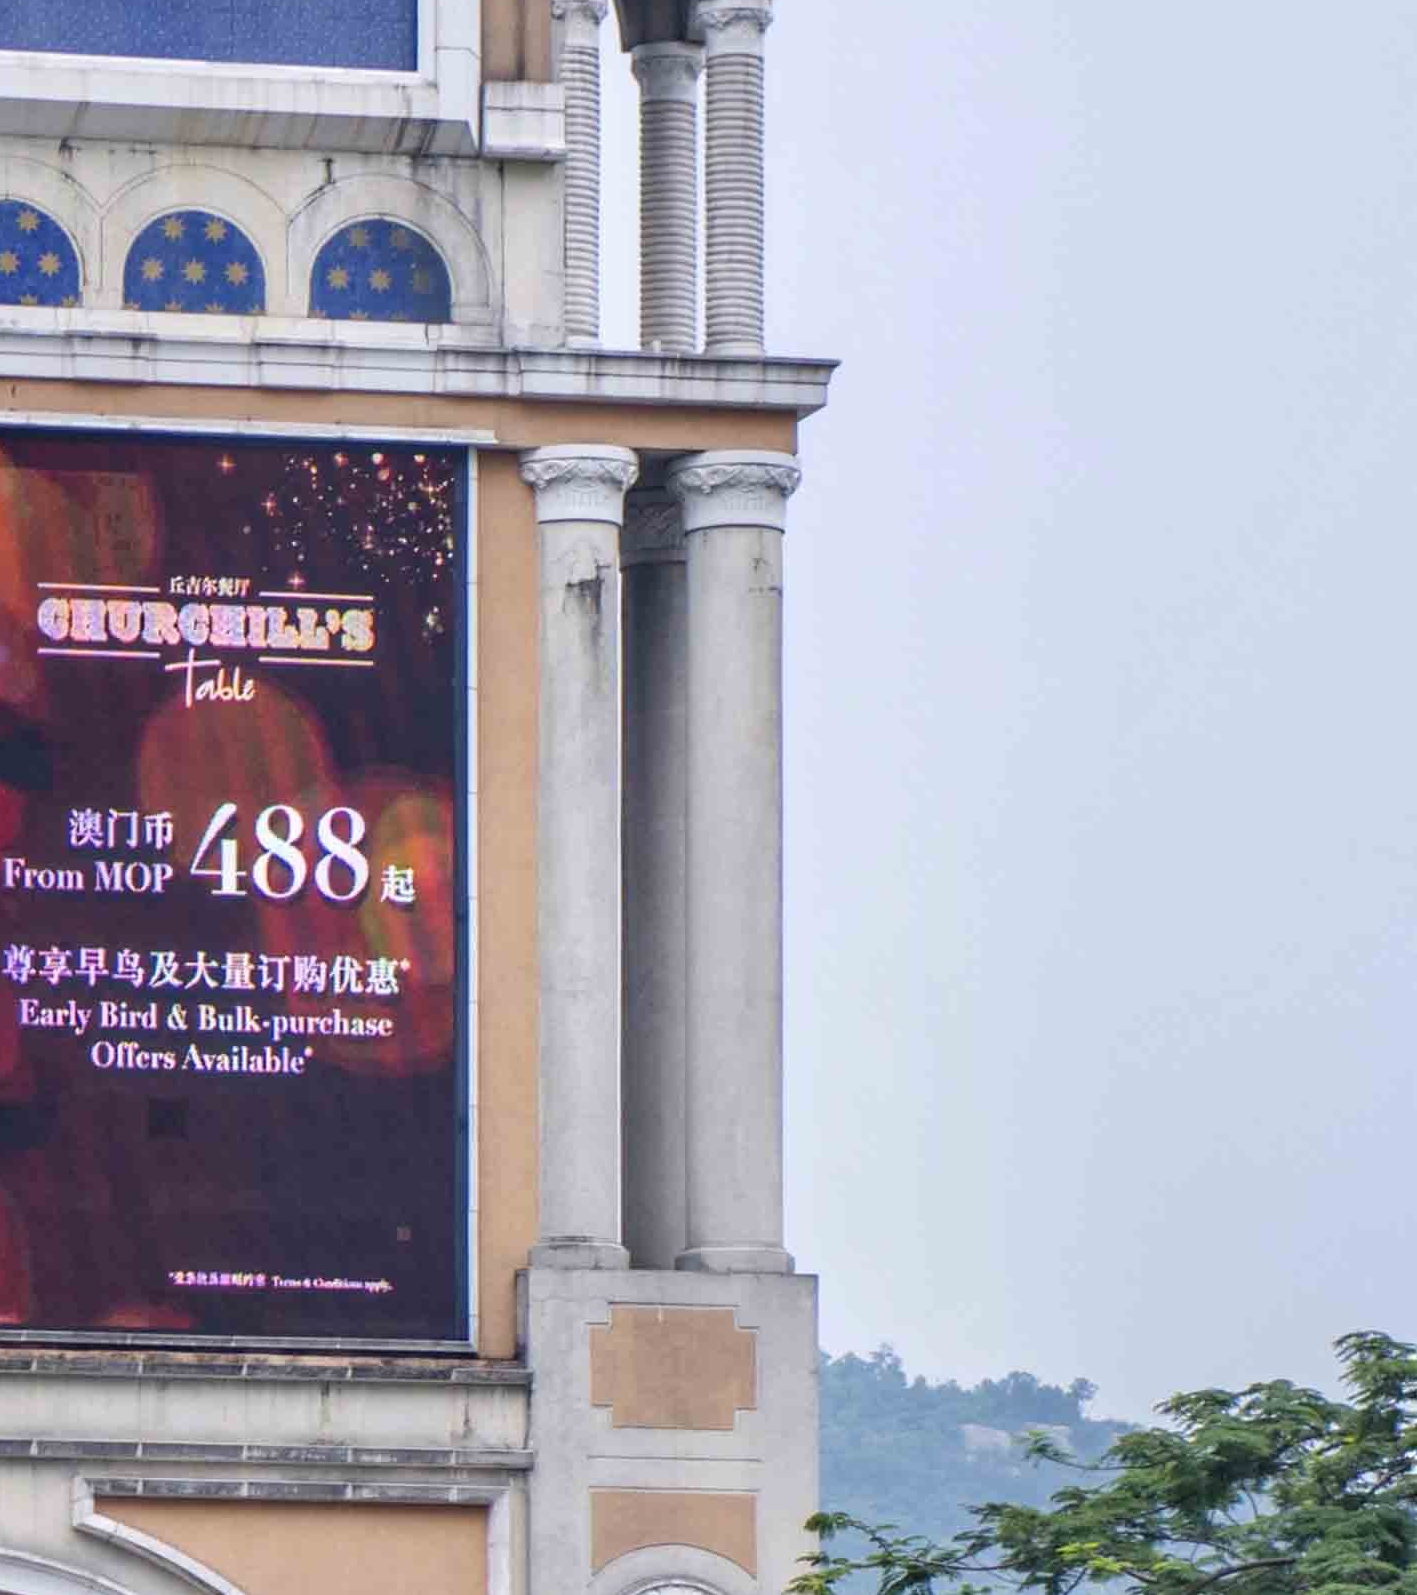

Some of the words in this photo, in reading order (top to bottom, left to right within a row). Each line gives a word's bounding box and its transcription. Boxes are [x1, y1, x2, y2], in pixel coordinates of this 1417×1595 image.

[36, 597, 376, 652] CHURCHILL'S
[165, 648, 255, 708] Table
[3, 858, 84, 892] From
[94, 862, 174, 894] MOP
[189, 802, 370, 902] 488
[379, 864, 417, 903] 起
[68, 807, 175, 850] 澳门币
[18, 998, 92, 1036] Early
[100, 1000, 158, 1031] Bird
[166, 1005, 189, 1032] &
[198, 1003, 394, 1042] Bulk-purchase
[90, 1040, 176, 1071] Offers
